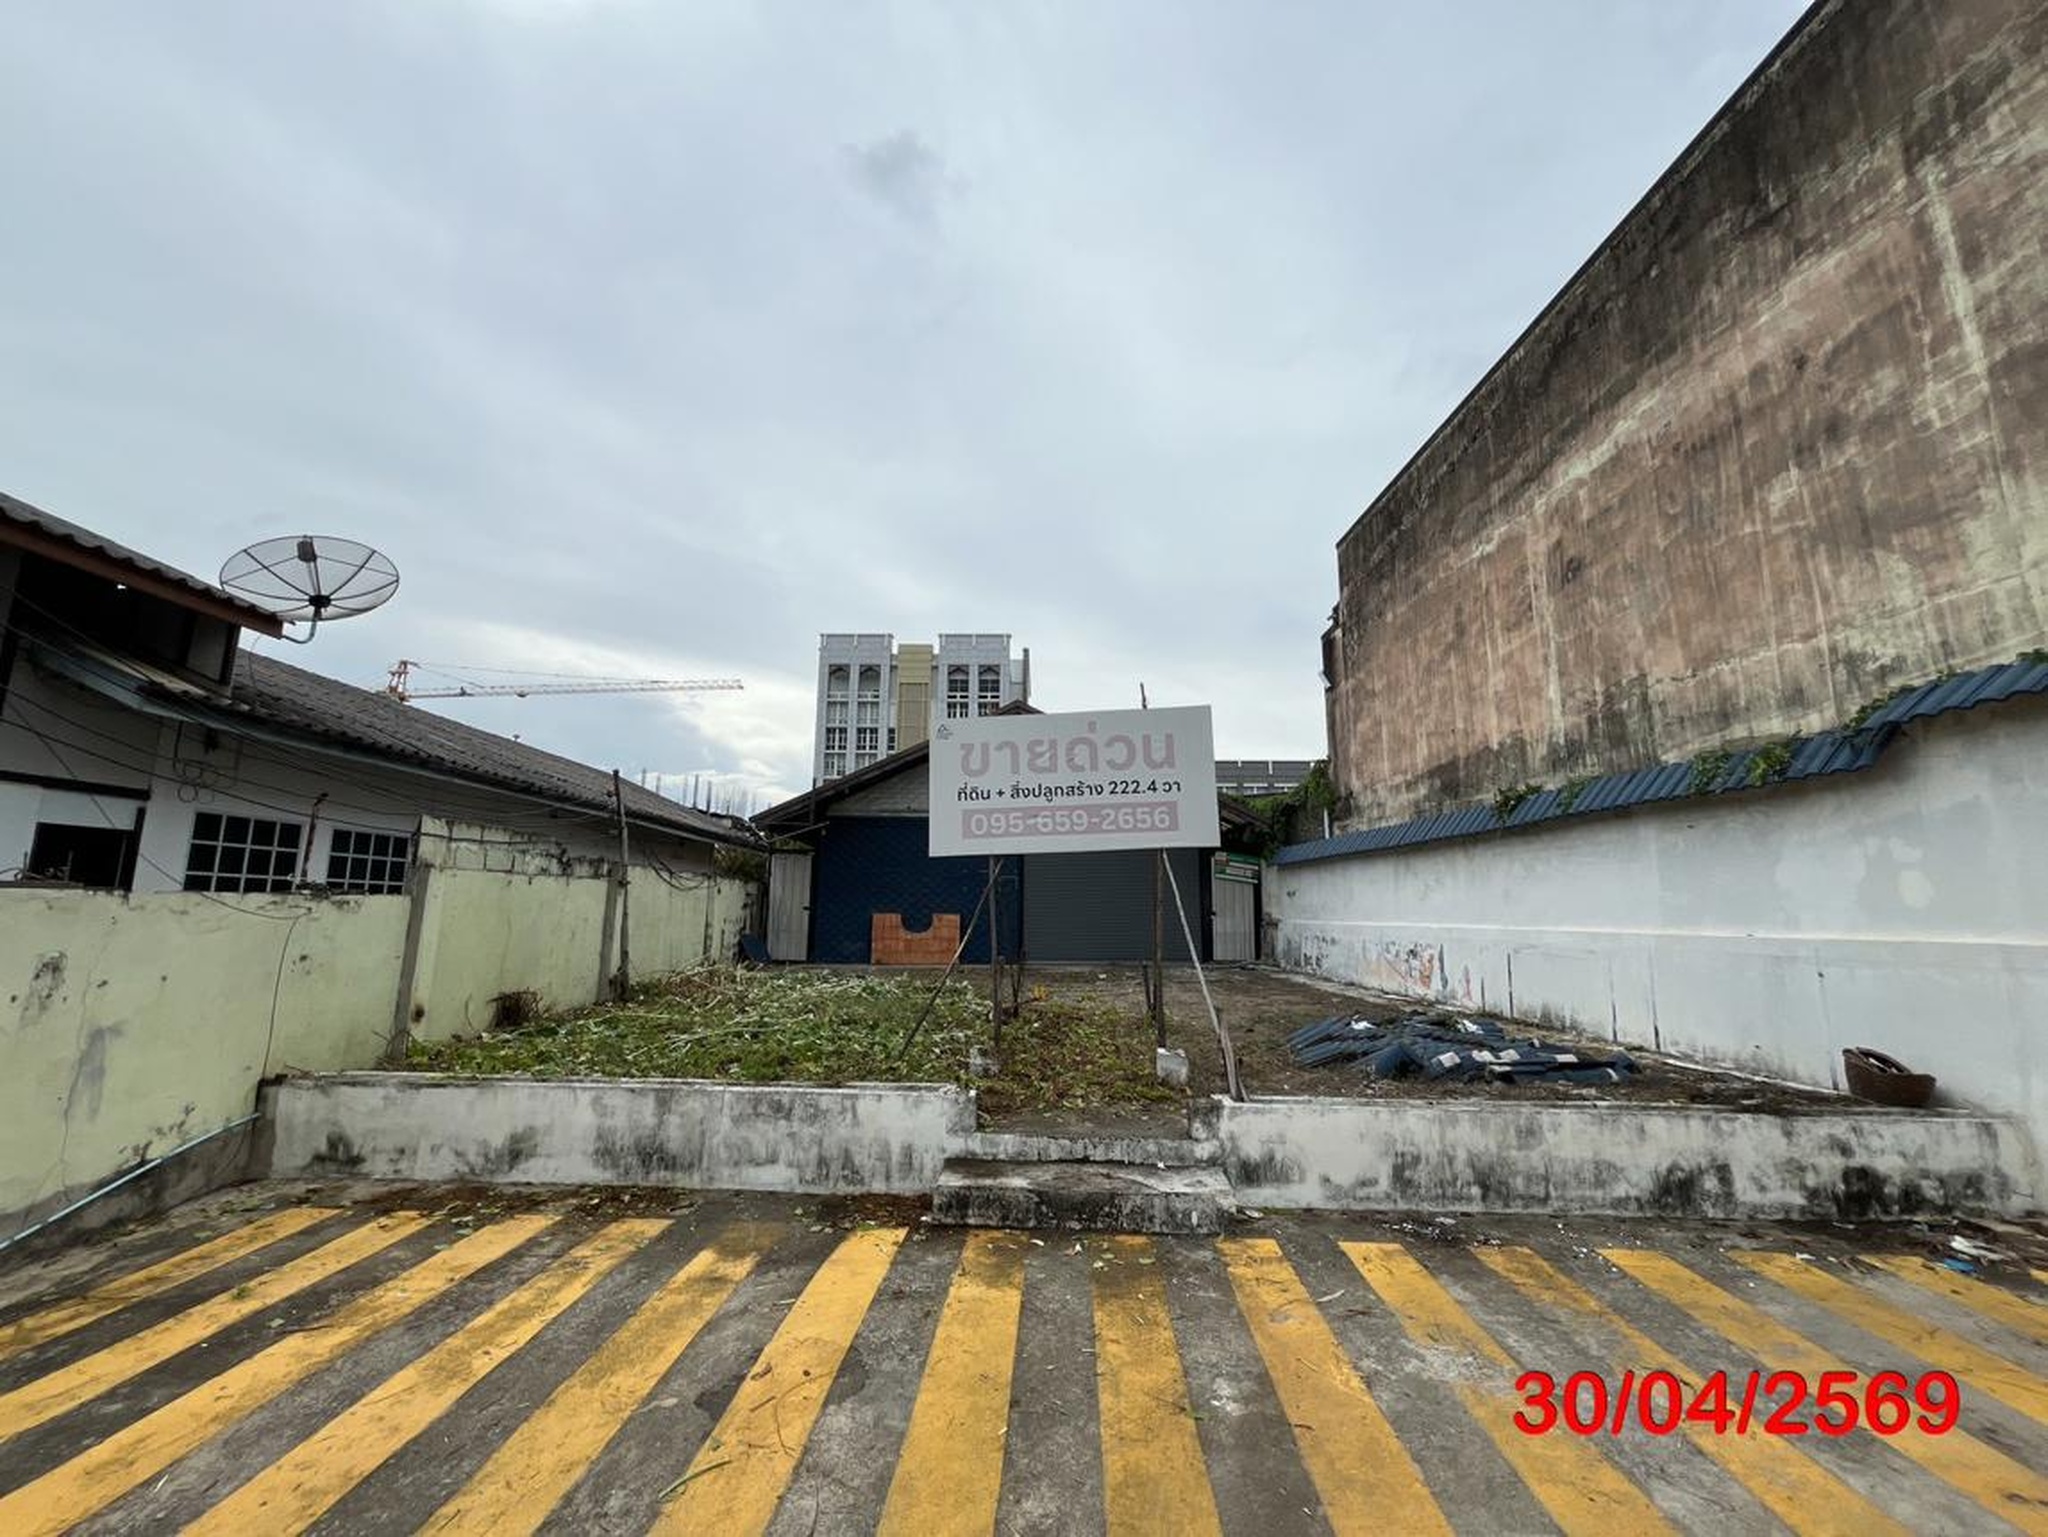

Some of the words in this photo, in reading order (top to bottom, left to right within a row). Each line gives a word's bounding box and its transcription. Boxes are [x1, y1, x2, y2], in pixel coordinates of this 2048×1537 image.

[960, 721, 1176, 777] ขายด่วน
[957, 782, 991, 802] ที่ดิน
[996, 788, 1004, 798] +
[1010, 781, 1104, 803] สิ่งปลูกสร้าง
[1108, 779, 1158, 795] 222.4
[1162, 780, 1181, 793] วา
[971, 807, 1171, 835] 095-659-2656
